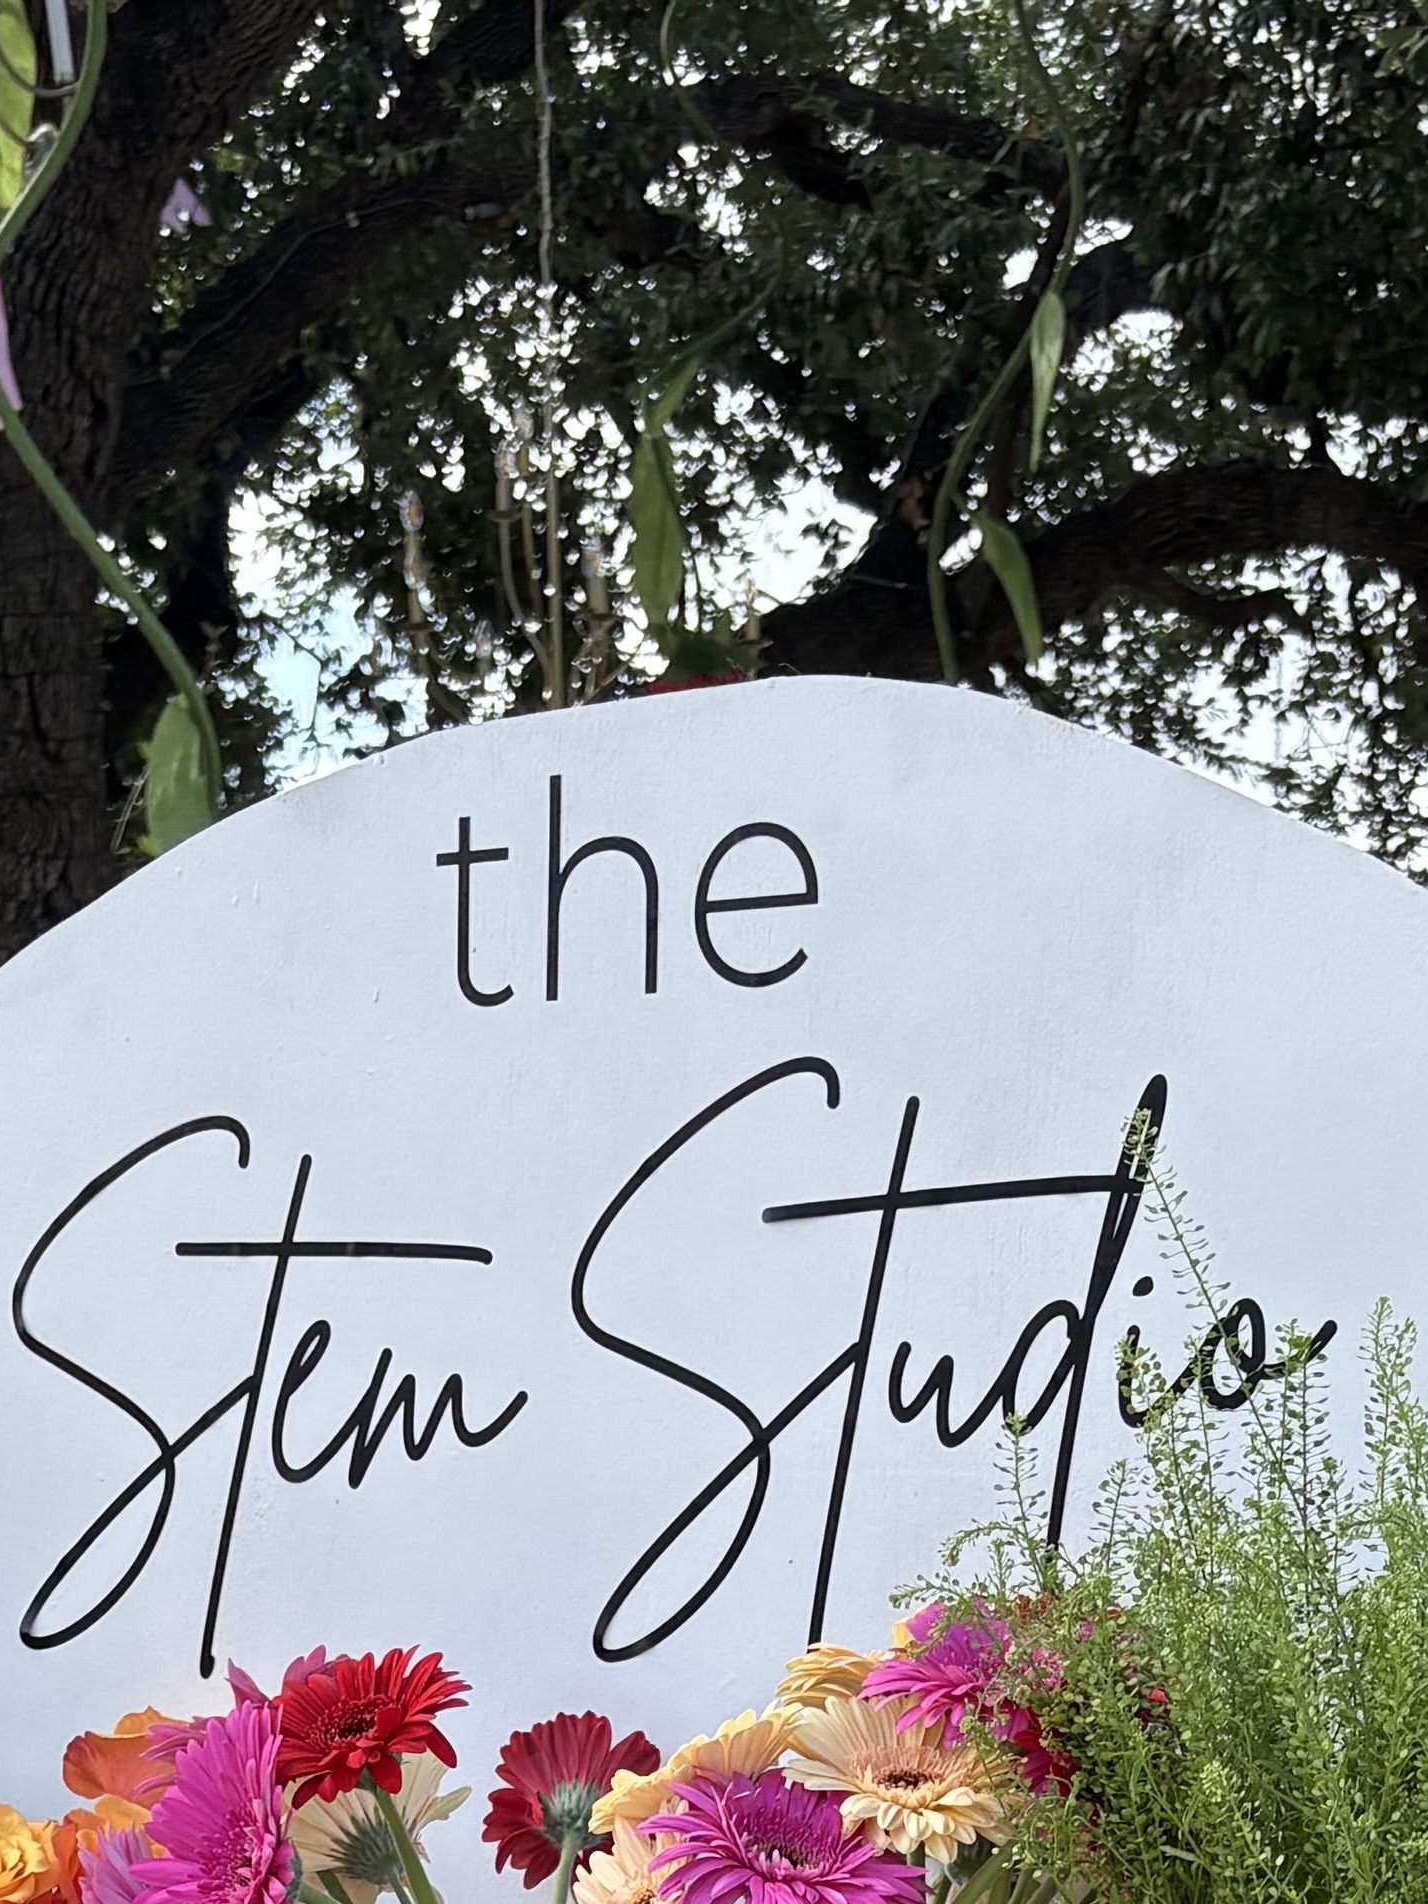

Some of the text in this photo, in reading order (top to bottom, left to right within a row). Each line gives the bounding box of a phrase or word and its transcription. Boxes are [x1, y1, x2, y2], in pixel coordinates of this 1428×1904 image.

[436, 774, 820, 1007] the
[12, 1056, 1336, 1677] Stem Studio
